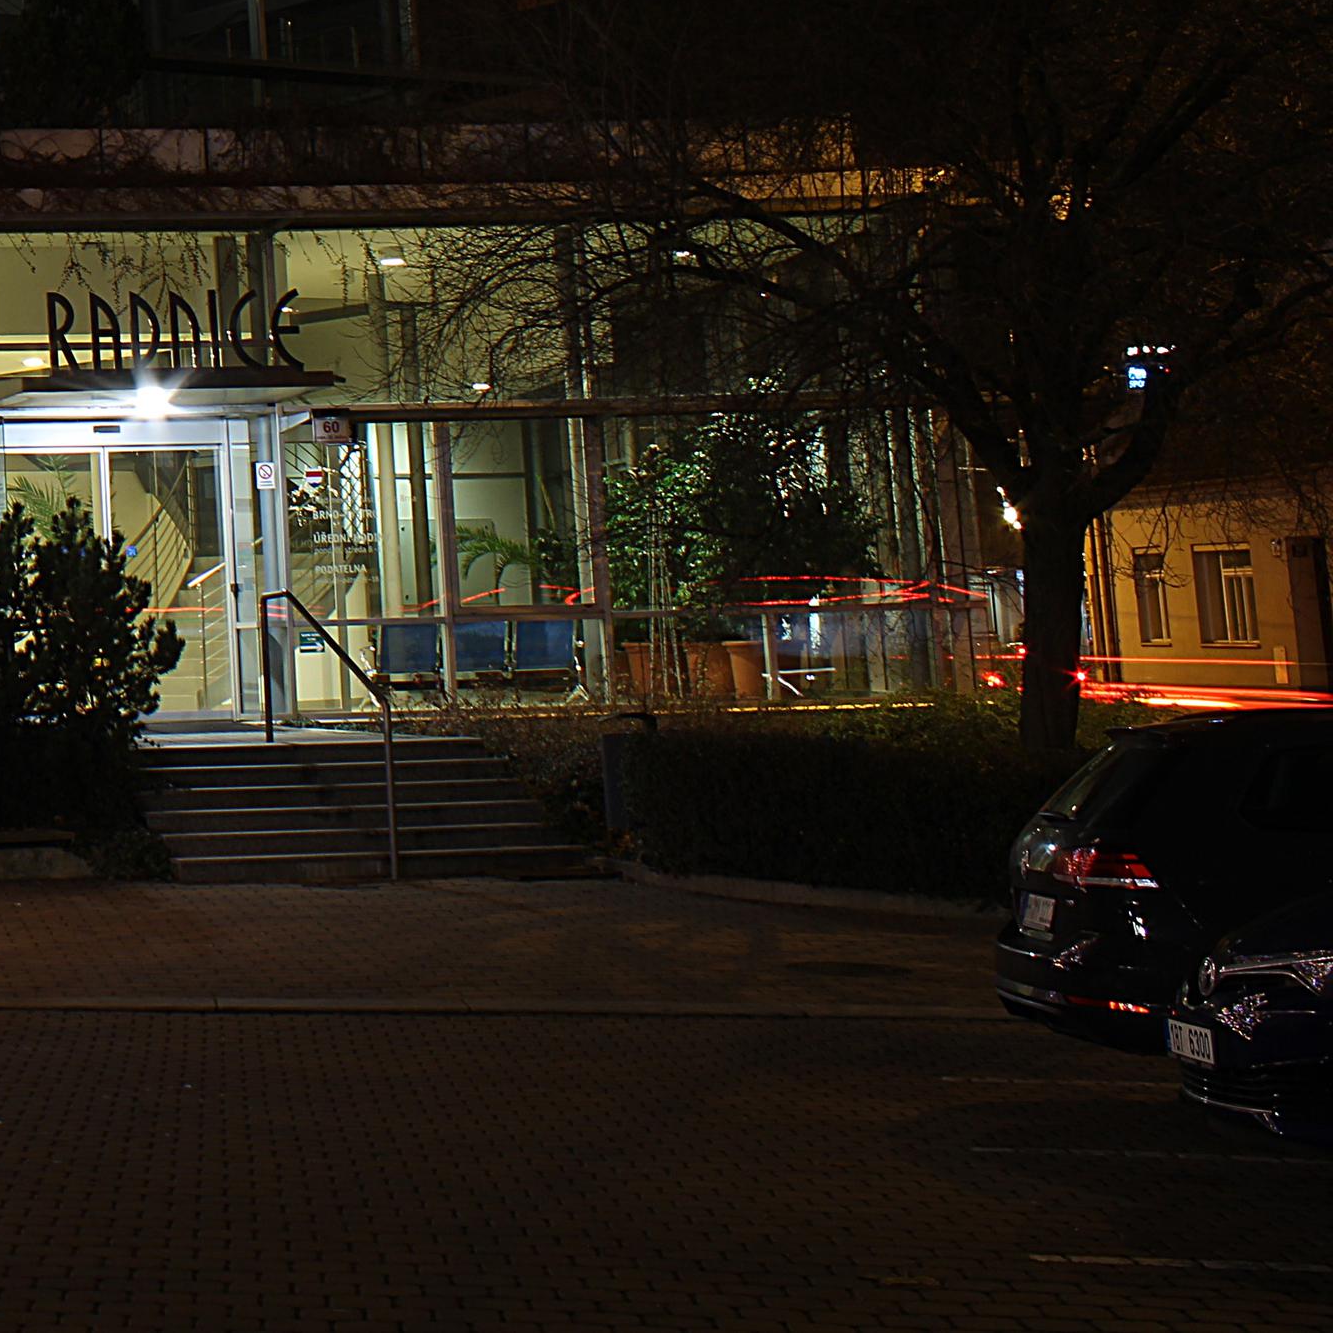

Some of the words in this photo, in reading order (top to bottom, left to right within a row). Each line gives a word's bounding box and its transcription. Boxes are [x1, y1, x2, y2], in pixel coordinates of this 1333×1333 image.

[47, 289, 304, 371] RADNICE
[323, 420, 340, 434] 60
[1189, 1028, 1211, 1060] 6300
